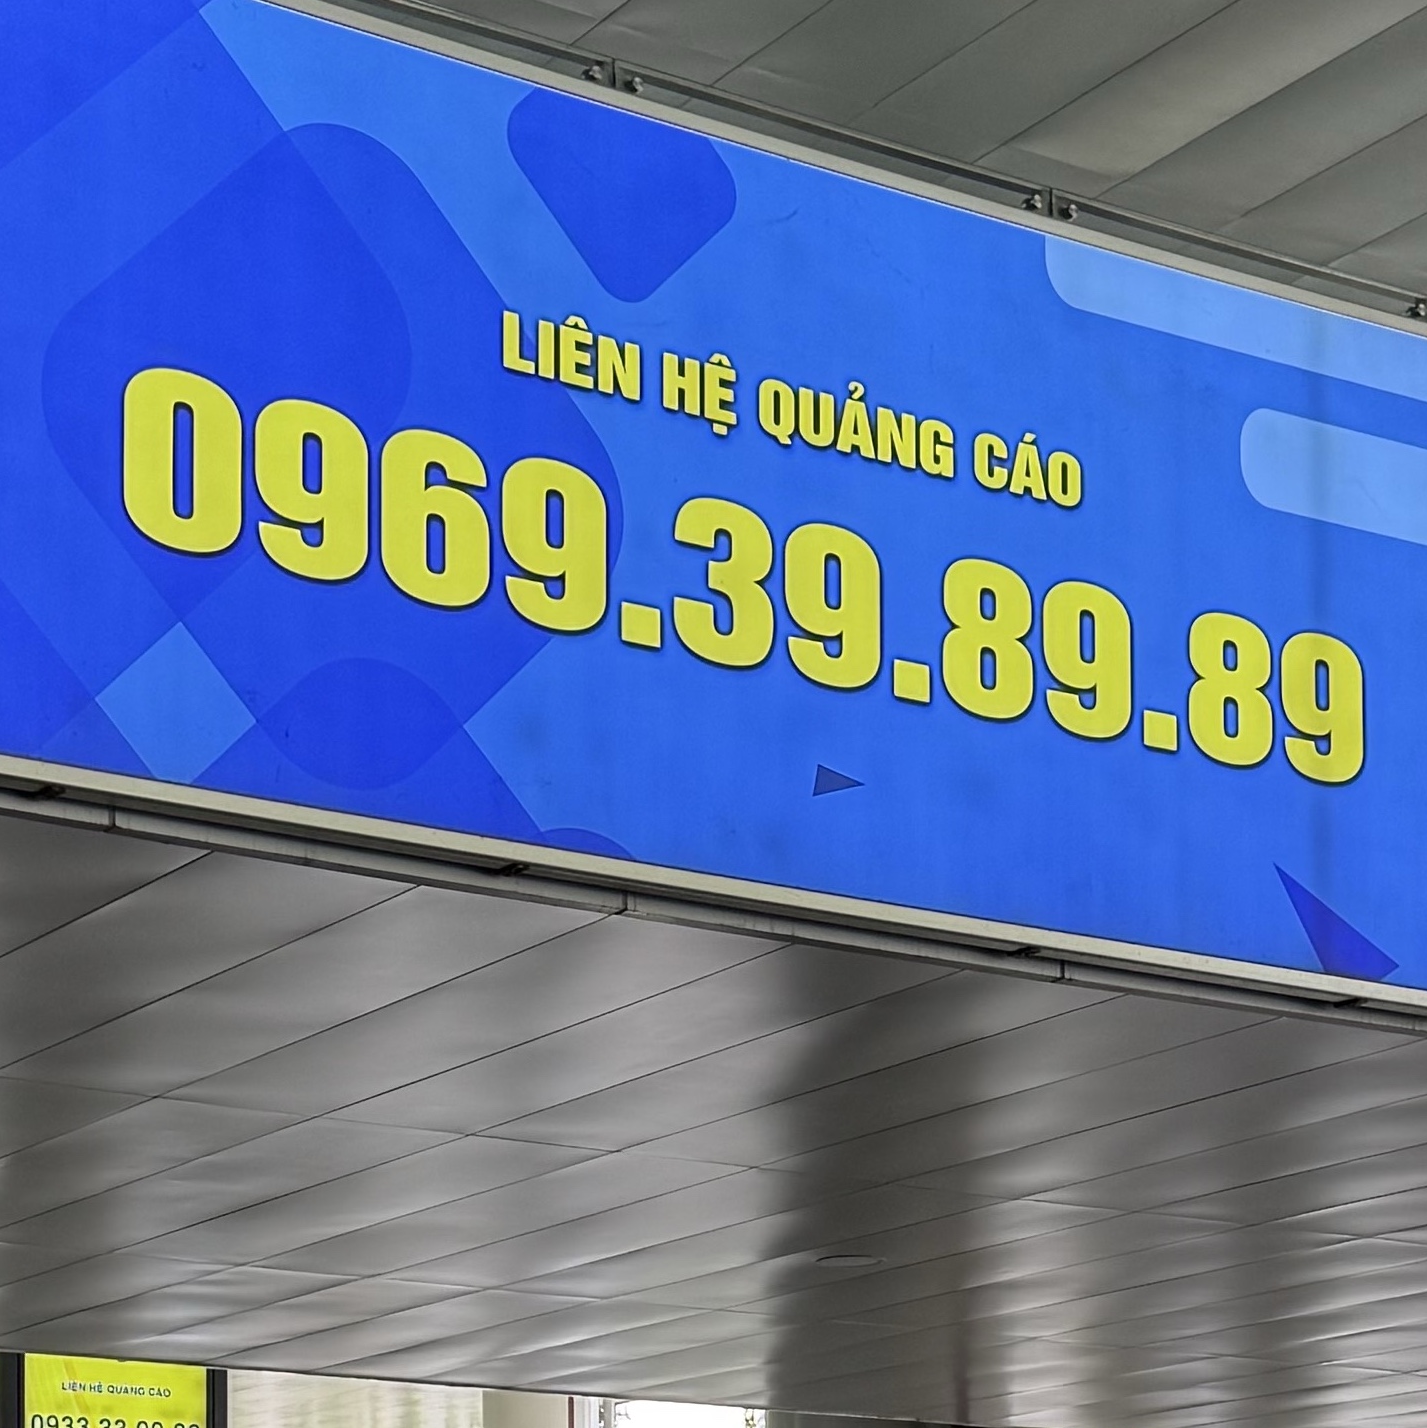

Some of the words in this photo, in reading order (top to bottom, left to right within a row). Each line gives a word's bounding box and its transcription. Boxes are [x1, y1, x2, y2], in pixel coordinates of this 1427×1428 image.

[502, 310, 642, 403] LIÊN
[662, 353, 738, 434] HỆ
[758, 382, 956, 481] QUẢNG
[972, 433, 1085, 510] CÁO
[121, 366, 1367, 786] 0969.39.89.89
